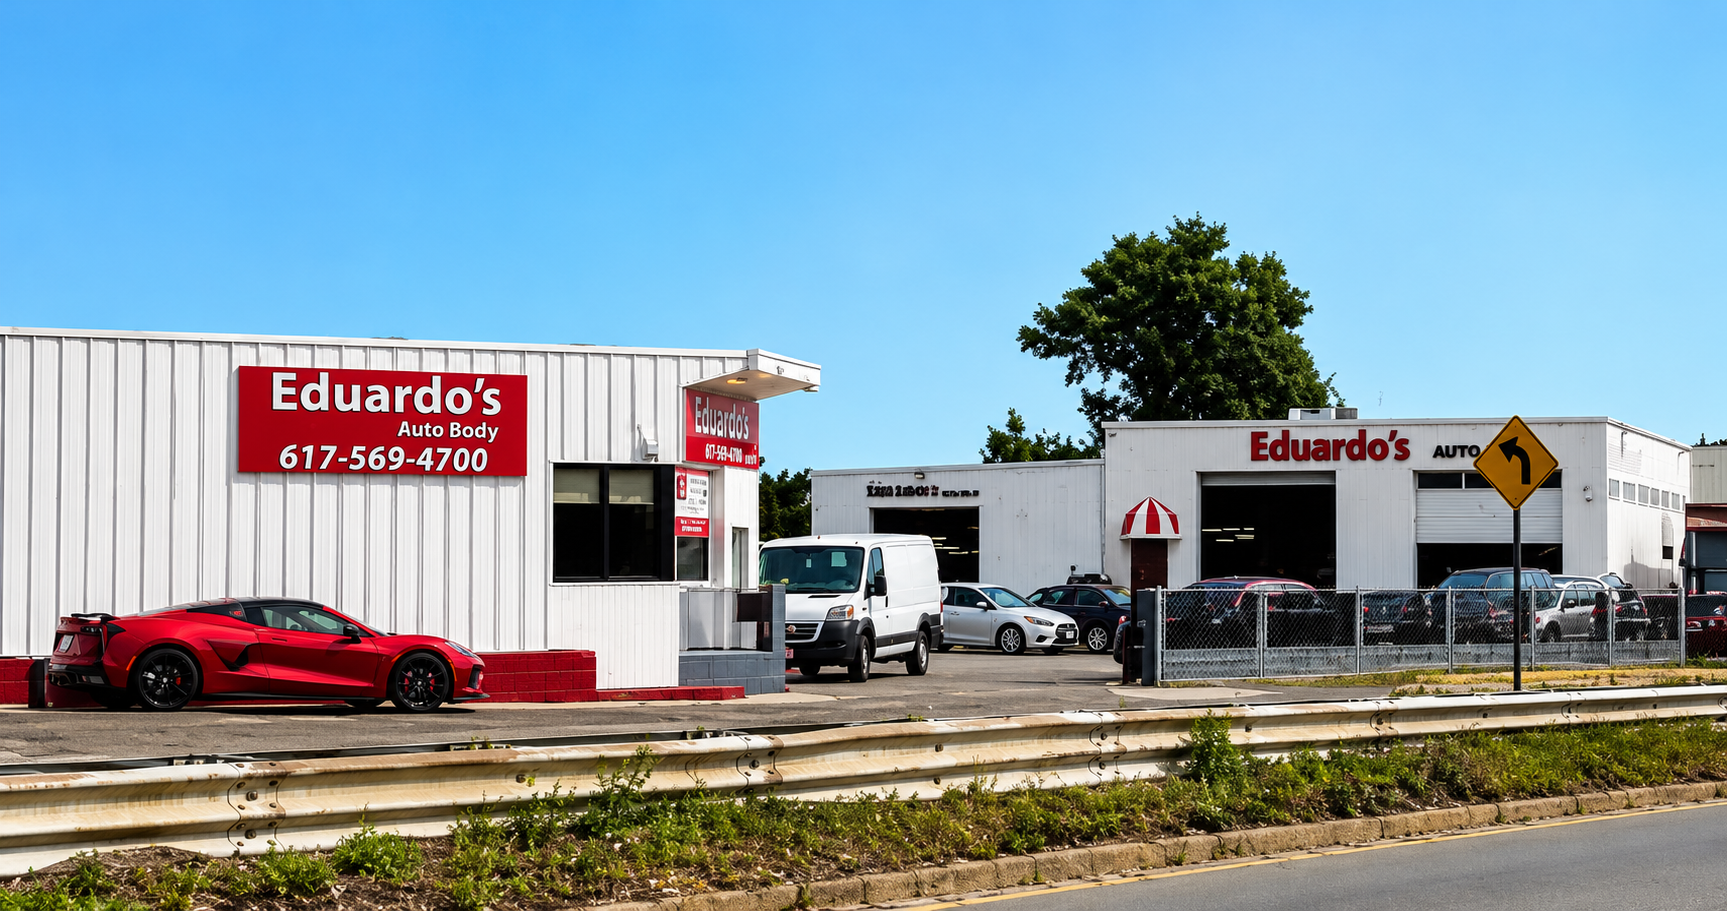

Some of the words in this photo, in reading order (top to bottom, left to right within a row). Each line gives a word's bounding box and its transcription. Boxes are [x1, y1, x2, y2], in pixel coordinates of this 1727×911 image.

[271, 371, 501, 415] Eduardo's
[397, 421, 444, 438] Auto
[449, 421, 499, 443] Body
[1250, 429, 1411, 462] Eduardo's
[1432, 444, 1481, 459] AUTO
[279, 444, 488, 472] 617-569-4700
